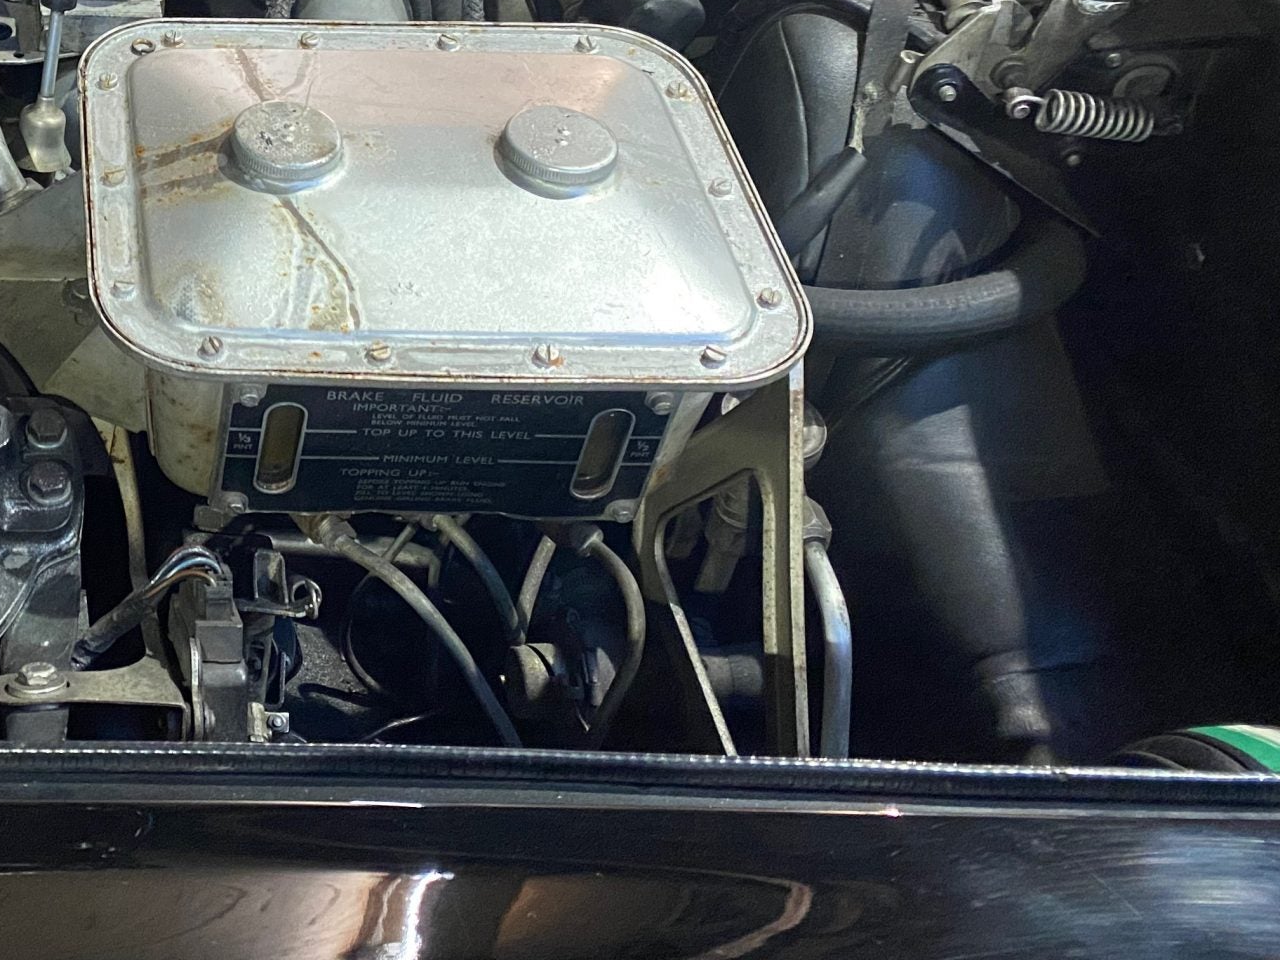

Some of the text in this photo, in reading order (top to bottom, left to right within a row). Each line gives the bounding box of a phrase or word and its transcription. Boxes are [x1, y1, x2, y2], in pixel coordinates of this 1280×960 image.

[326, 391, 585, 406] BRAKE FLUID RESERVOIR
[362, 428, 532, 441] TOP UP TO THIS LEVEL
[382, 454, 496, 465] MINIMUM LEVEL
[339, 467, 402, 478] TOPPING
